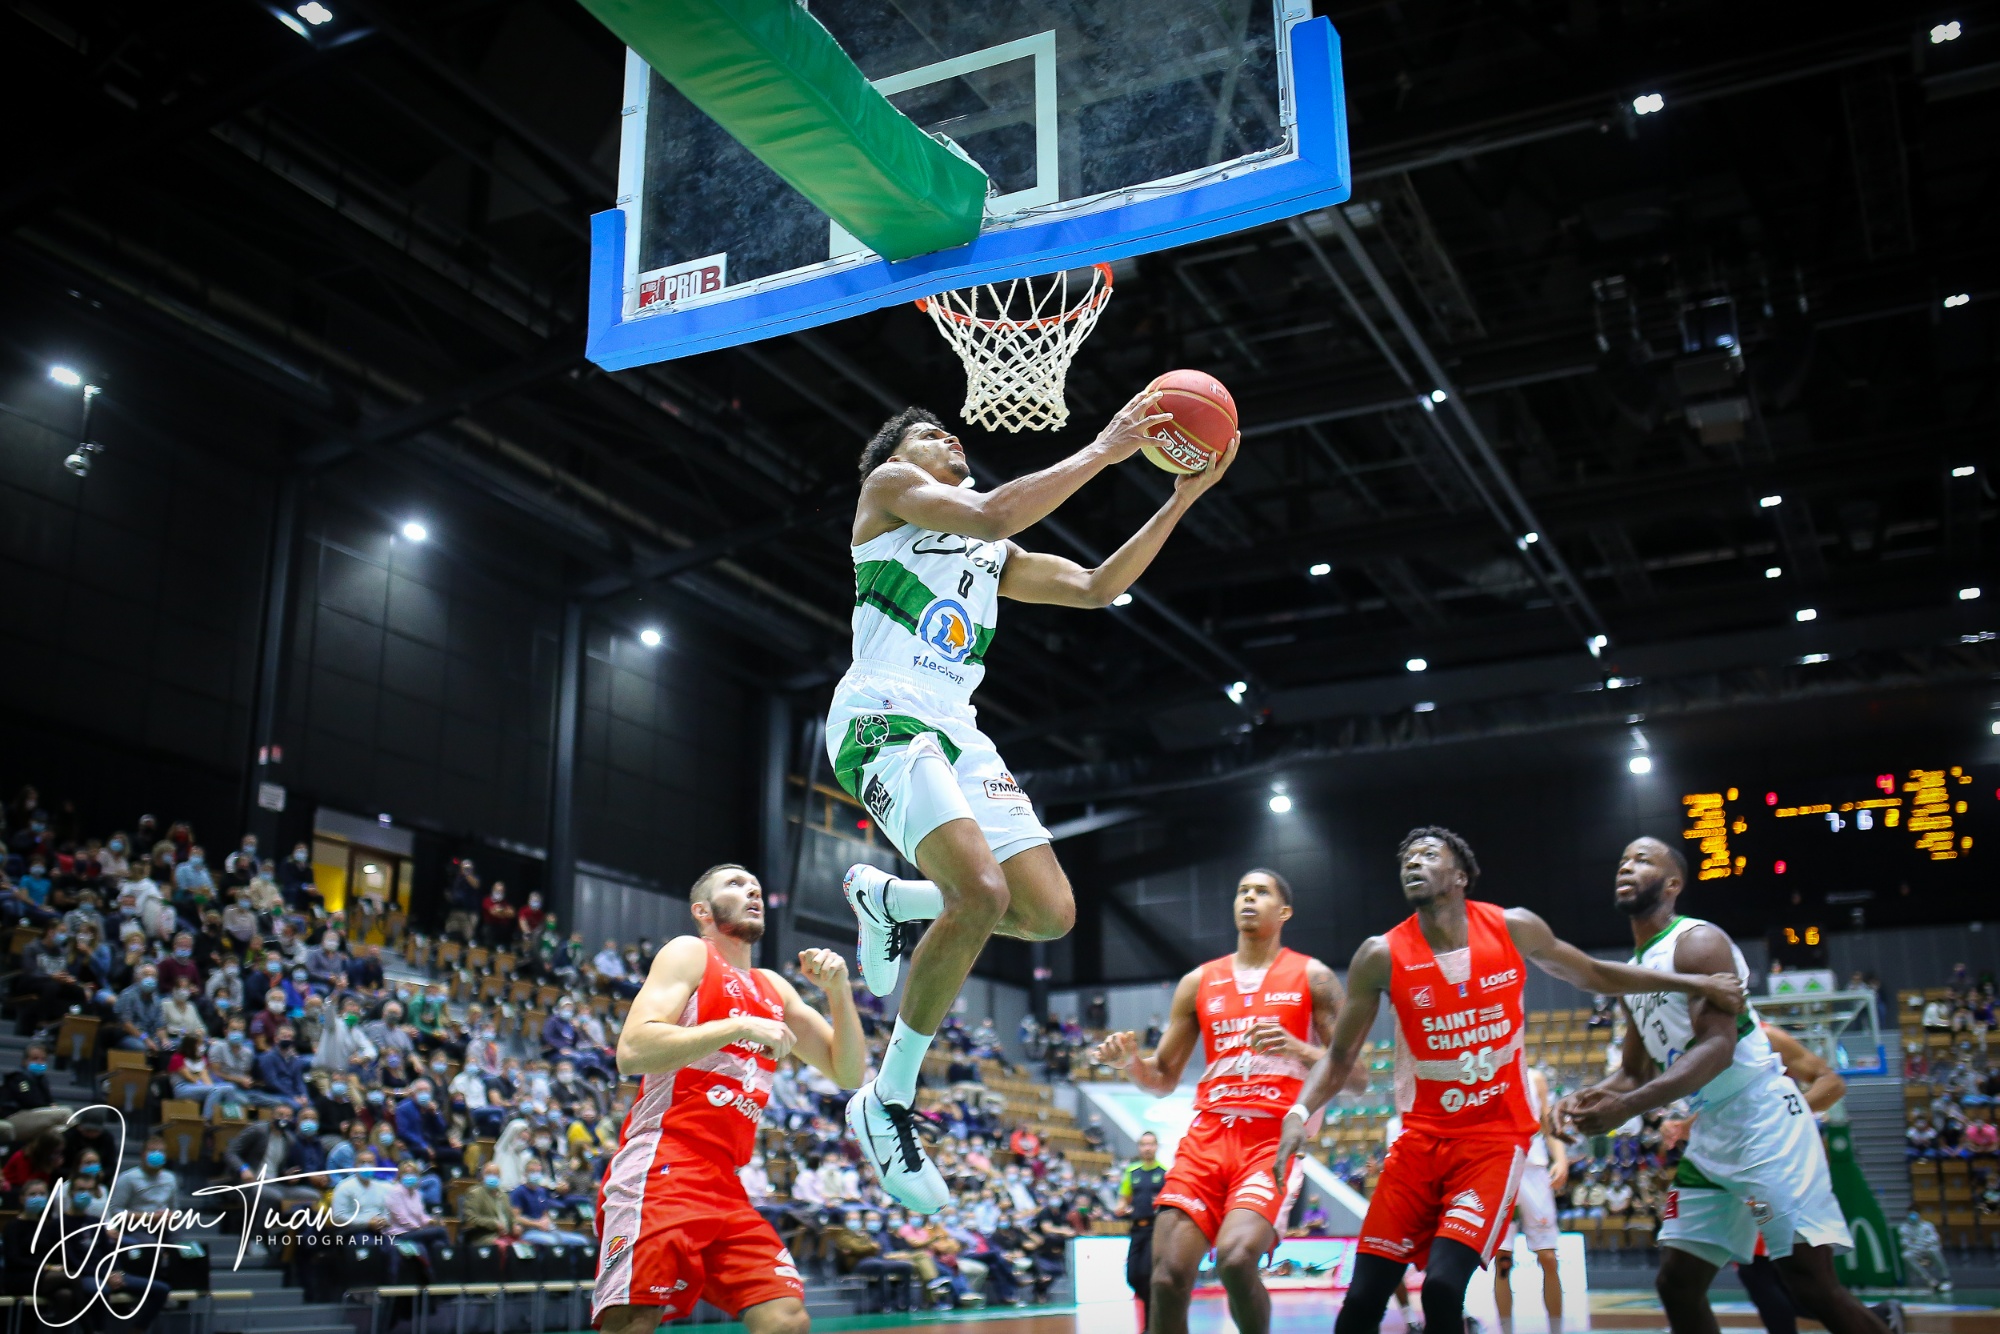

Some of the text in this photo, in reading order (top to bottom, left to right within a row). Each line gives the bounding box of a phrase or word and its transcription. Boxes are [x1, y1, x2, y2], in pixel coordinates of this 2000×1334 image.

[1421, 1008, 1476, 1033] SAINT
[1427, 1018, 1512, 1052] CHAMOND
[742, 1057, 758, 1093] 8
[1234, 1050, 1254, 1081] 4
[1458, 1046, 1496, 1086] 35
